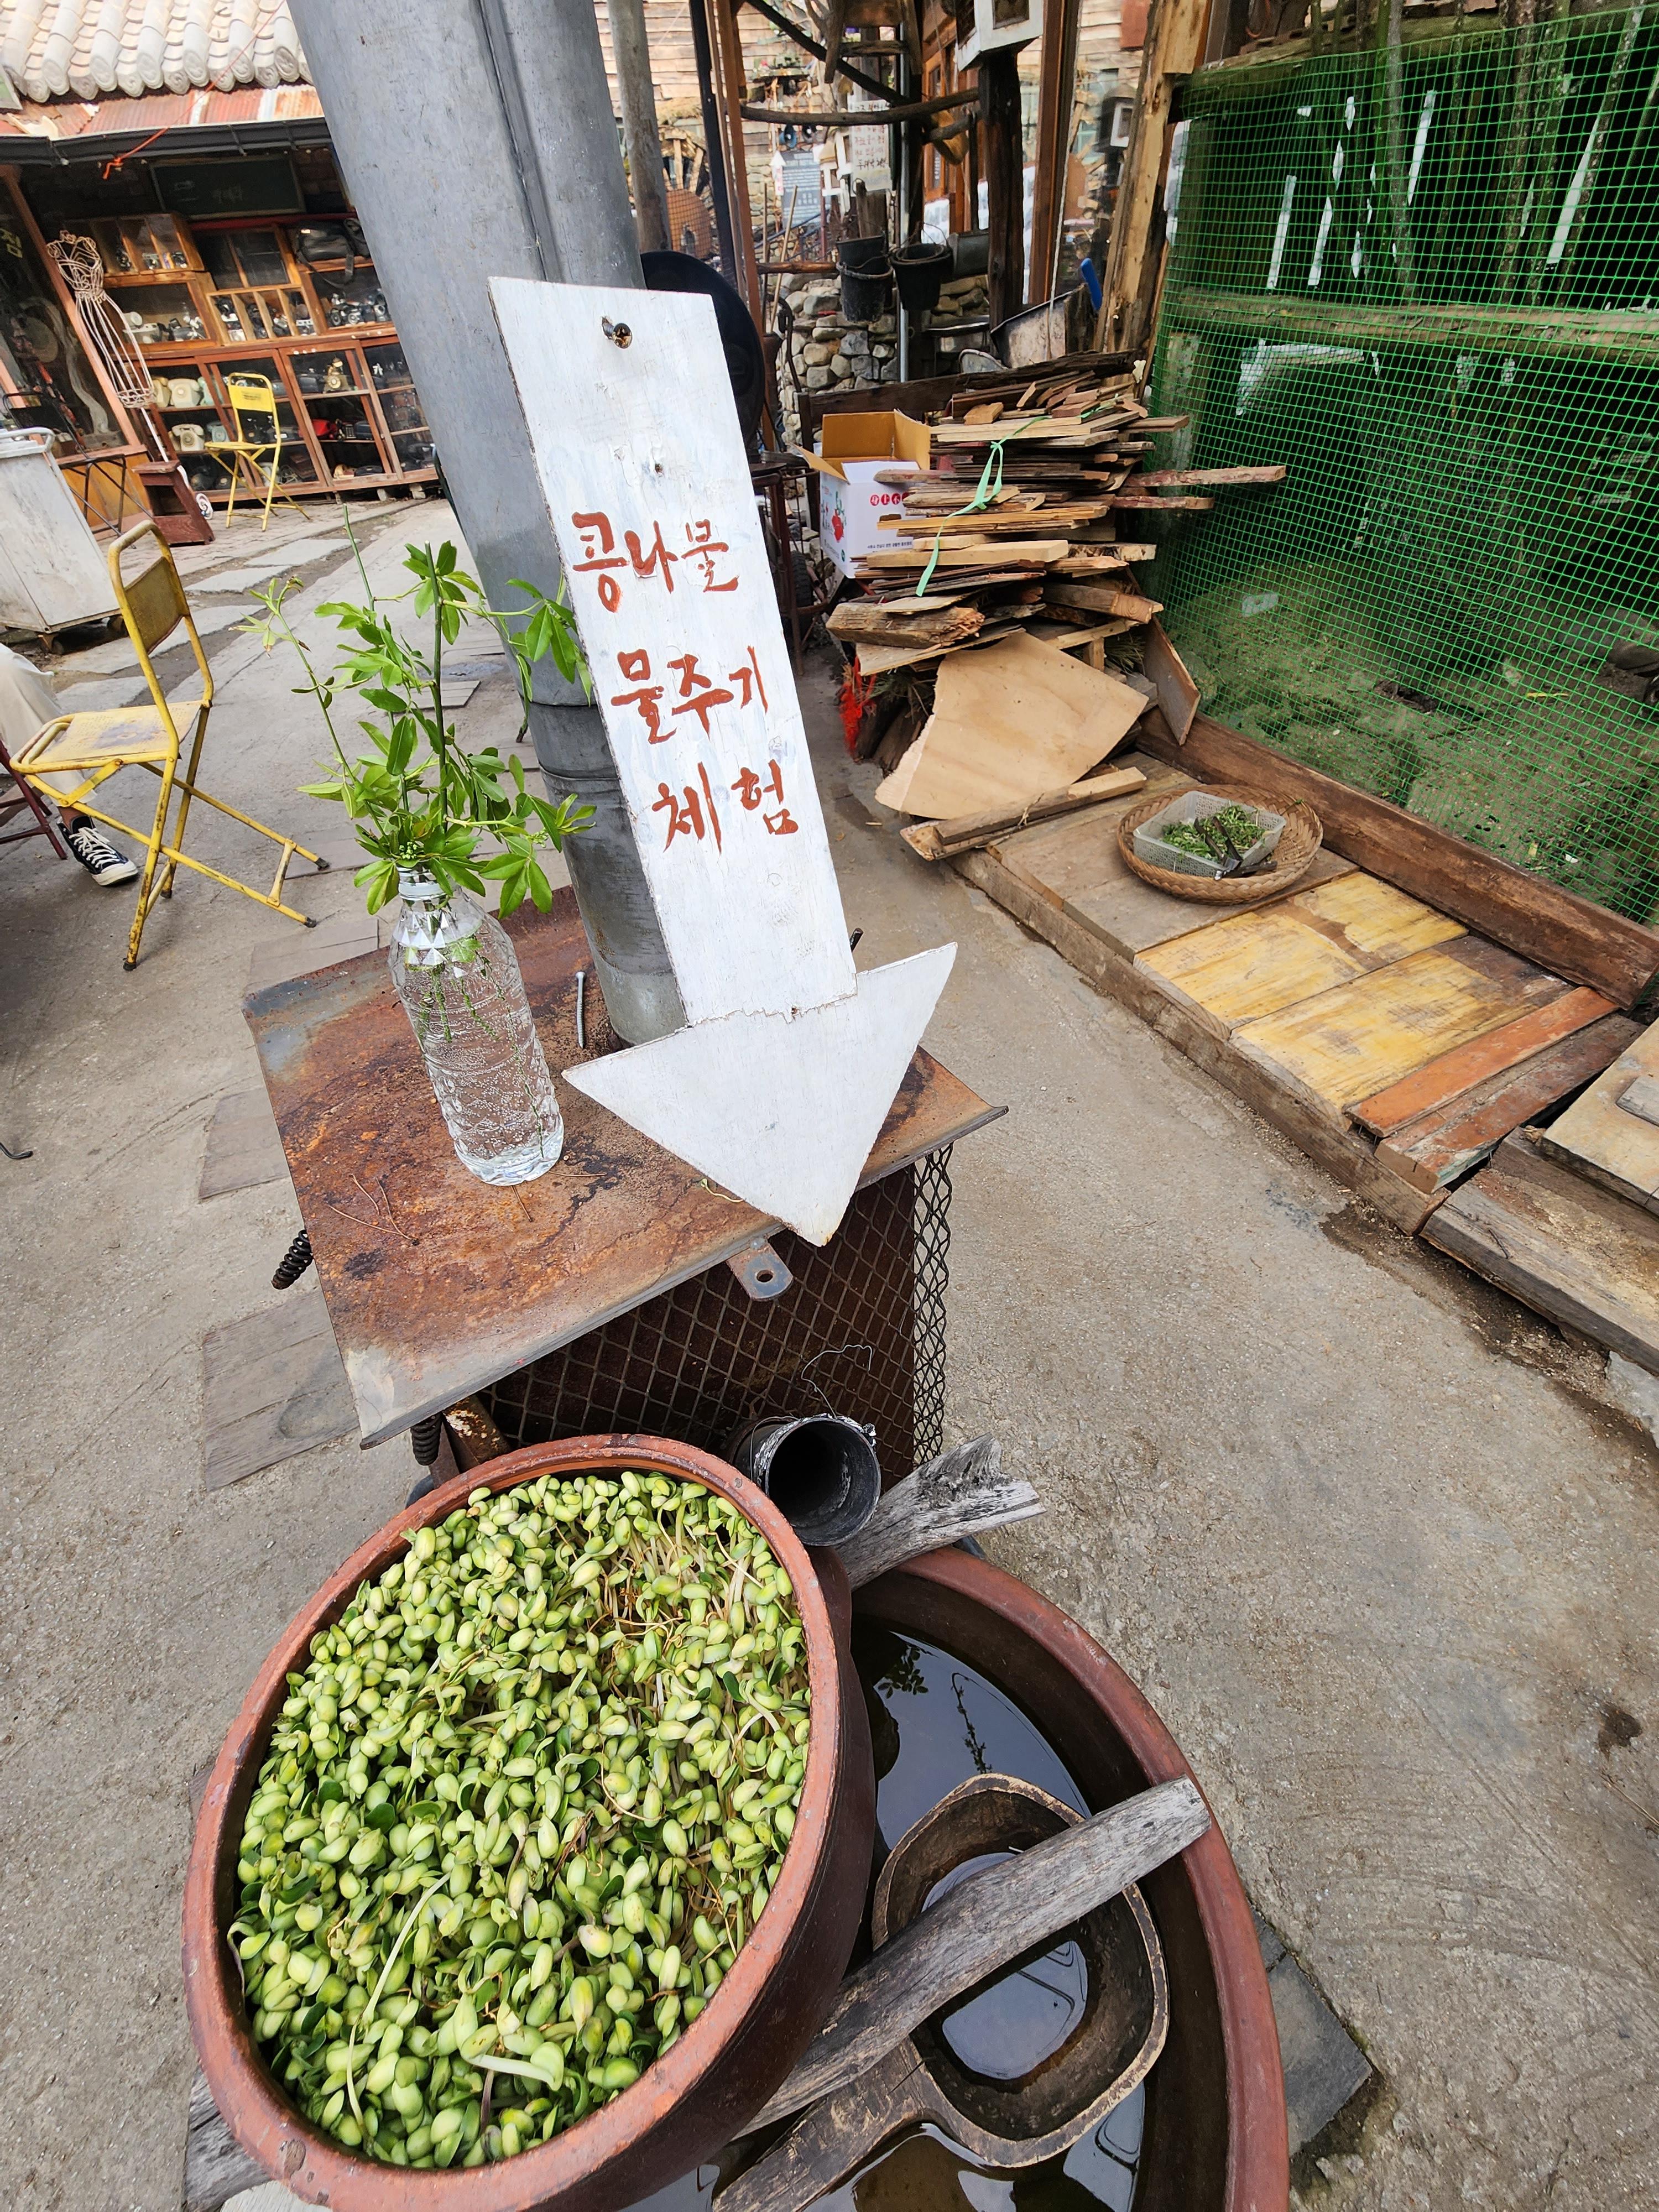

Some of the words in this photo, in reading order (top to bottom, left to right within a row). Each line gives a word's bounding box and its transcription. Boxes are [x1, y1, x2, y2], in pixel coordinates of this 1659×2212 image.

[572, 512, 739, 613] 콩나물
[611, 645, 768, 744] 물주기
[652, 759, 799, 854] 체험
